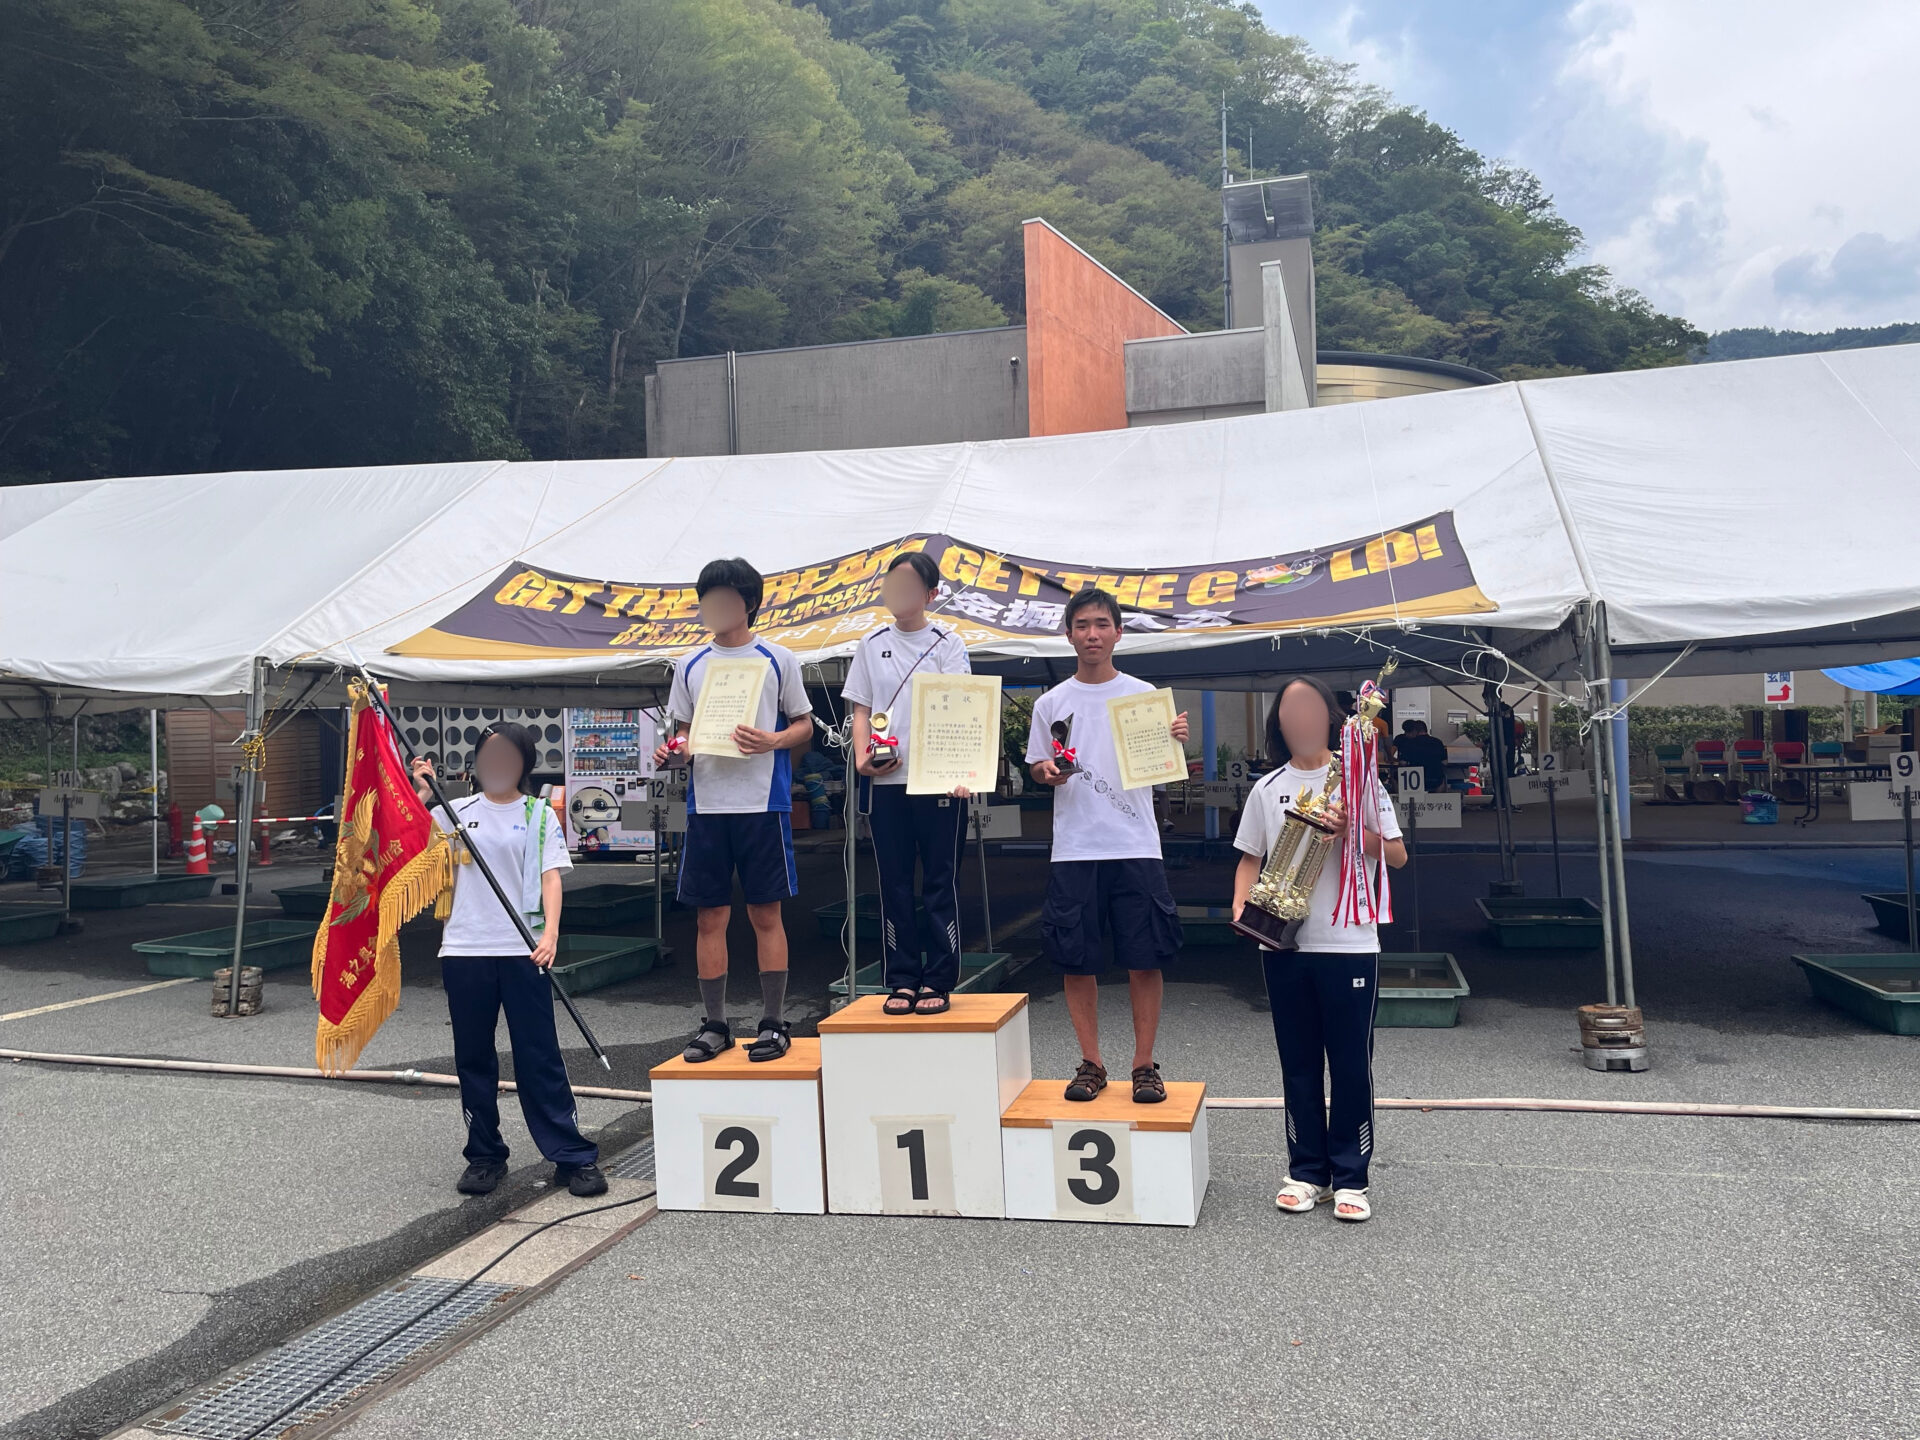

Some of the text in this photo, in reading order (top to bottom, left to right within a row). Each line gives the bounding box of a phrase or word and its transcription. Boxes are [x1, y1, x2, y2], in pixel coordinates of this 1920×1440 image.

[495, 570, 604, 614] GET
[602, 584, 700, 619] THE
[761, 539, 927, 608] REAM
[939, 545, 1048, 596] GET
[1056, 571, 1178, 609] THE
[624, 622, 669, 633] THE
[609, 631, 643, 645] OF
[639, 632, 701, 645] GOLD
[1231, 763, 1243, 778] 3
[1543, 754, 1556, 771] 2
[1896, 754, 1913, 777] 9
[60, 772, 71, 787] 14
[234, 766, 242, 778] 7
[436, 765, 444, 778] 6
[679, 769, 688, 781] 5
[650, 780, 665, 798] 12
[1400, 770, 1421, 791] 10
[714, 1126, 760, 1198] 2
[896, 1129, 929, 1200] 1
[1066, 1128, 1120, 1206] 3
